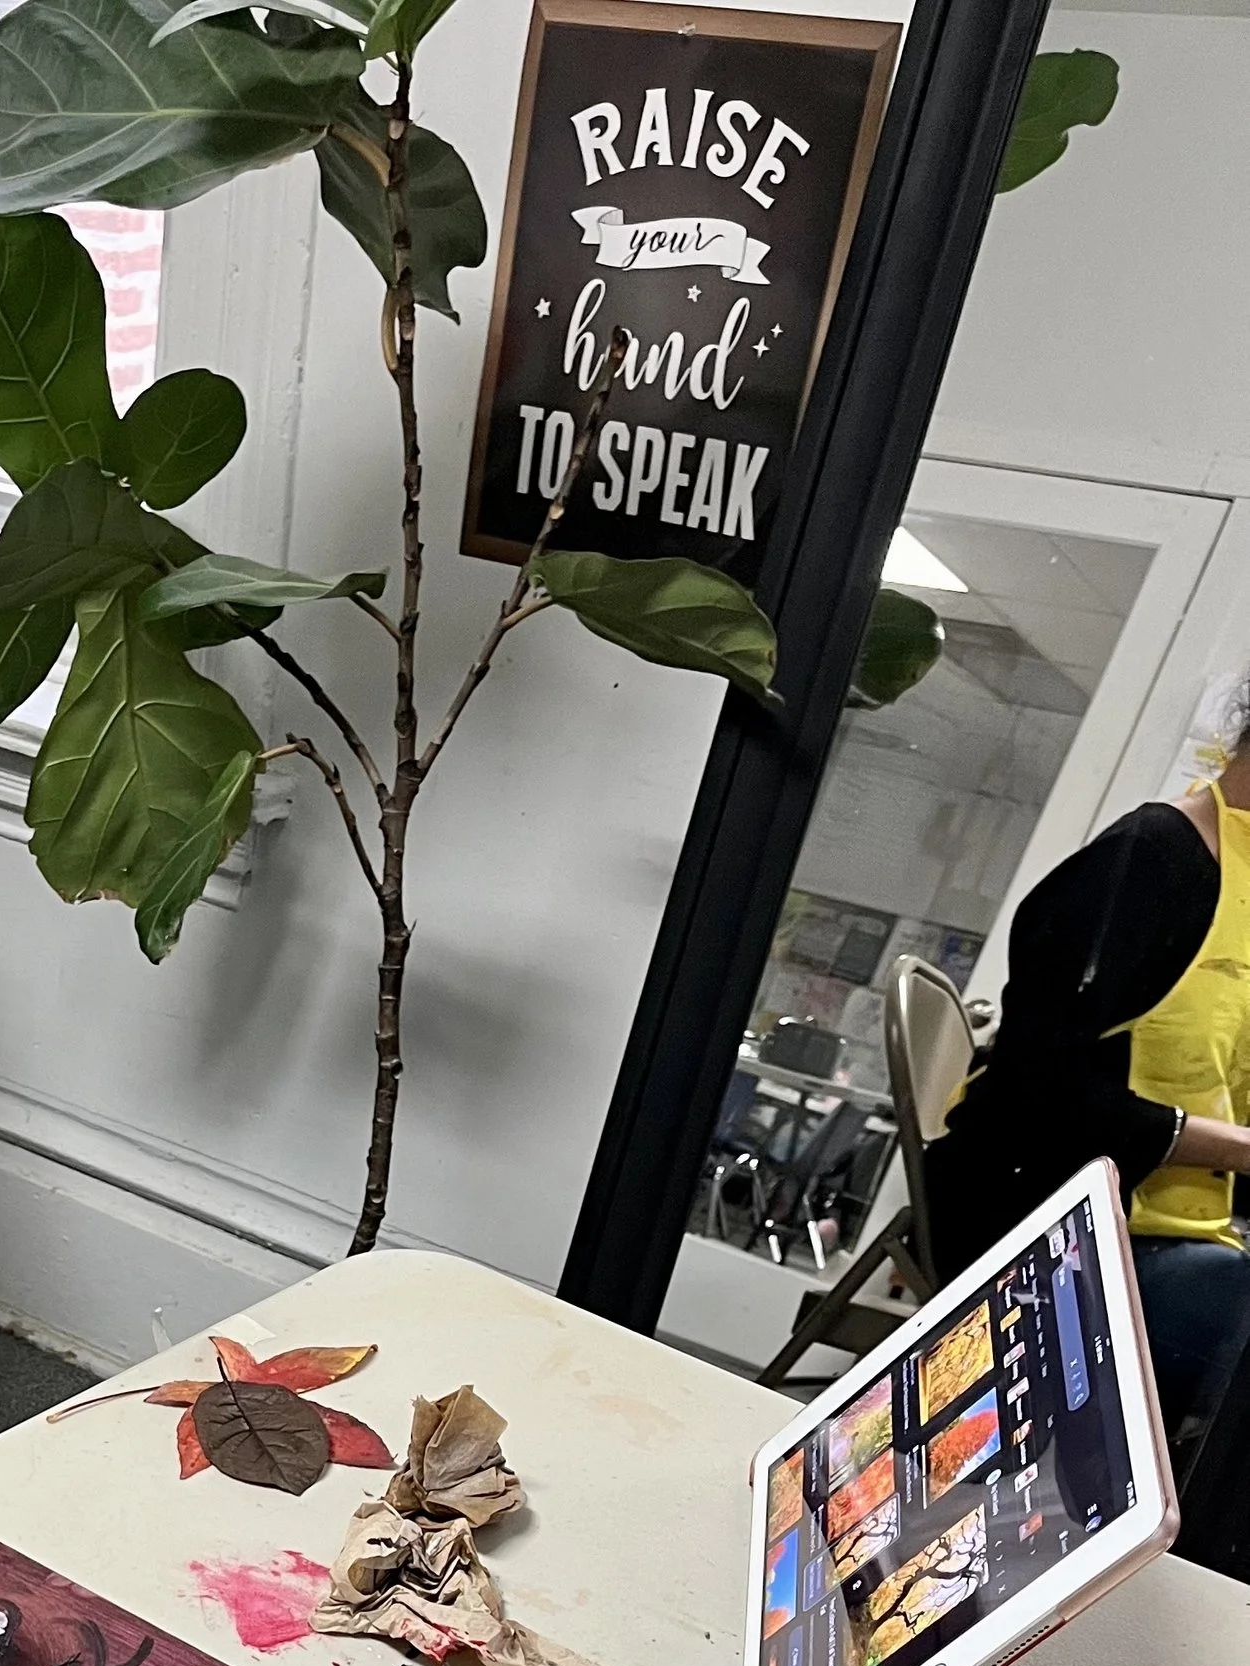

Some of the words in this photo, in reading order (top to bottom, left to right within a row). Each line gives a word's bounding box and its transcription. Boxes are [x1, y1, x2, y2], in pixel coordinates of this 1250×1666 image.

[570, 88, 810, 209] RAISE
[623, 223, 725, 271] your
[516, 404, 575, 500] TO
[592, 420, 770, 540] SPEAK
